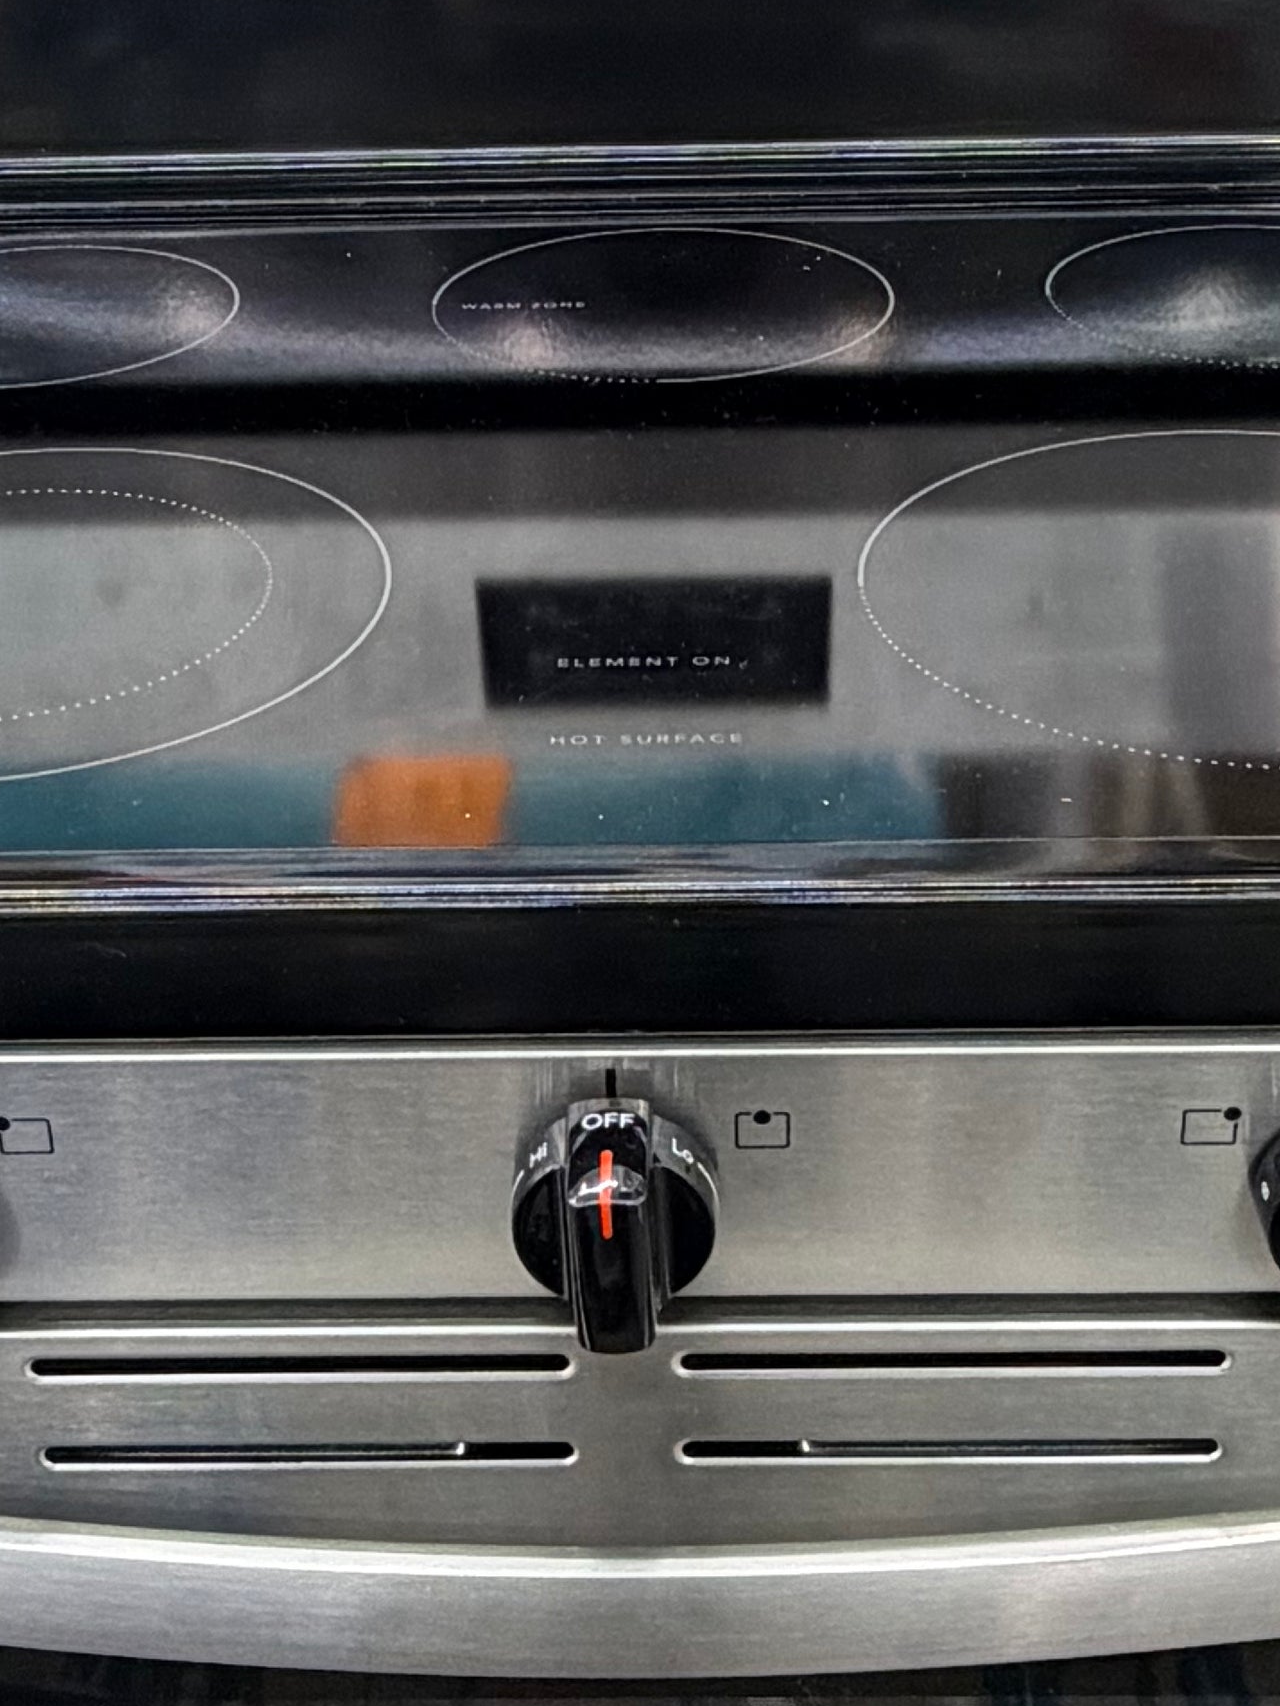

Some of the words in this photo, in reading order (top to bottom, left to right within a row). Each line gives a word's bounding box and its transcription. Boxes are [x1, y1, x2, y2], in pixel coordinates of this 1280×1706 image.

[461, 302, 522, 311] WARM
[531, 301, 586, 310] ZONE
[557, 655, 679, 669] ELEMENT
[692, 655, 731, 667] ON
[549, 734, 607, 746] HOT
[620, 732, 743, 745] SURFACE
[581, 1112, 635, 1130] OFF
